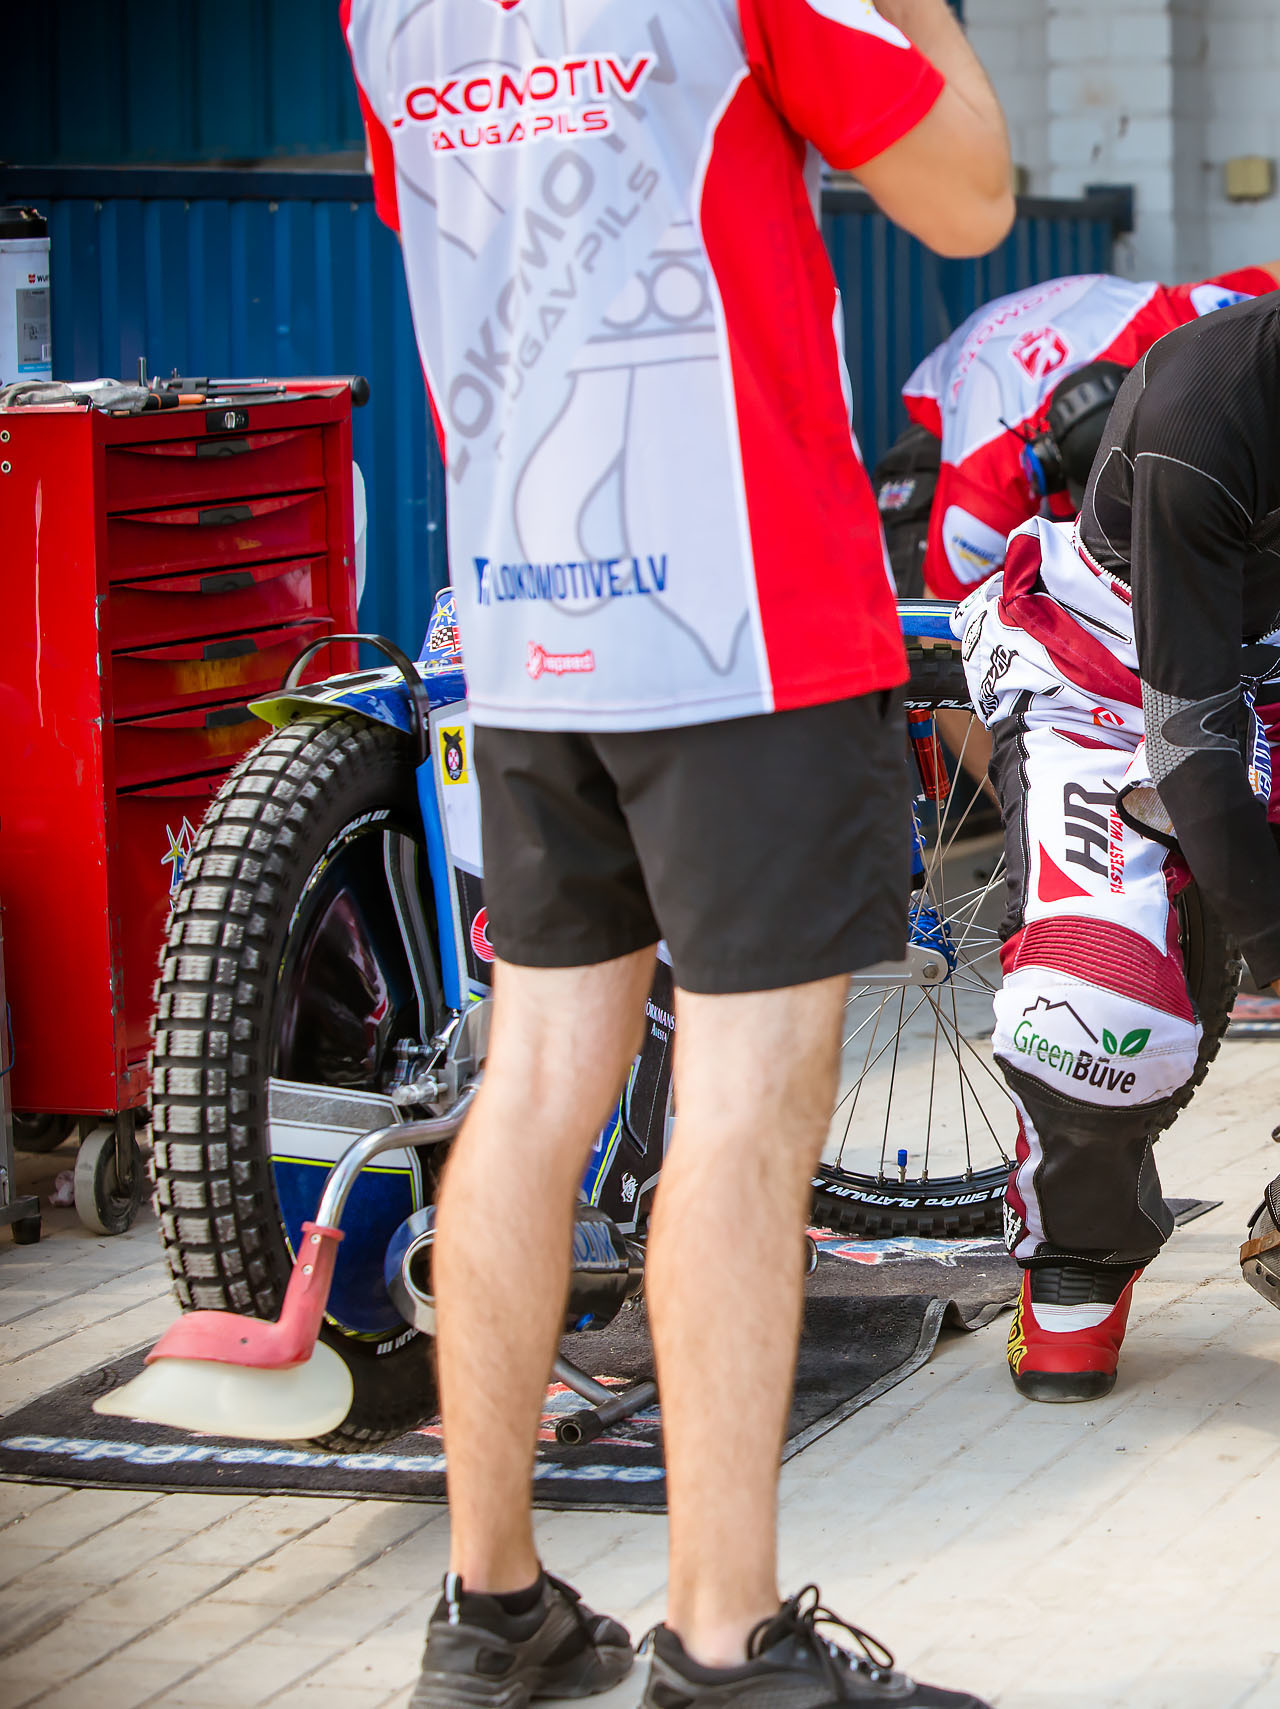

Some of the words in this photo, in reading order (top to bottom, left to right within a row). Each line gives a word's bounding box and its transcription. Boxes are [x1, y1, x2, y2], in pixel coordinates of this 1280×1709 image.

[392, 59, 649, 127] OKOMOTIV
[433, 110, 609, 151] AUGAPILS
[1110, 842, 1126, 894] FASTEST
[1013, 1020, 1137, 1094] GreenBūve
[825, 1184, 920, 1208] PLATINUM
